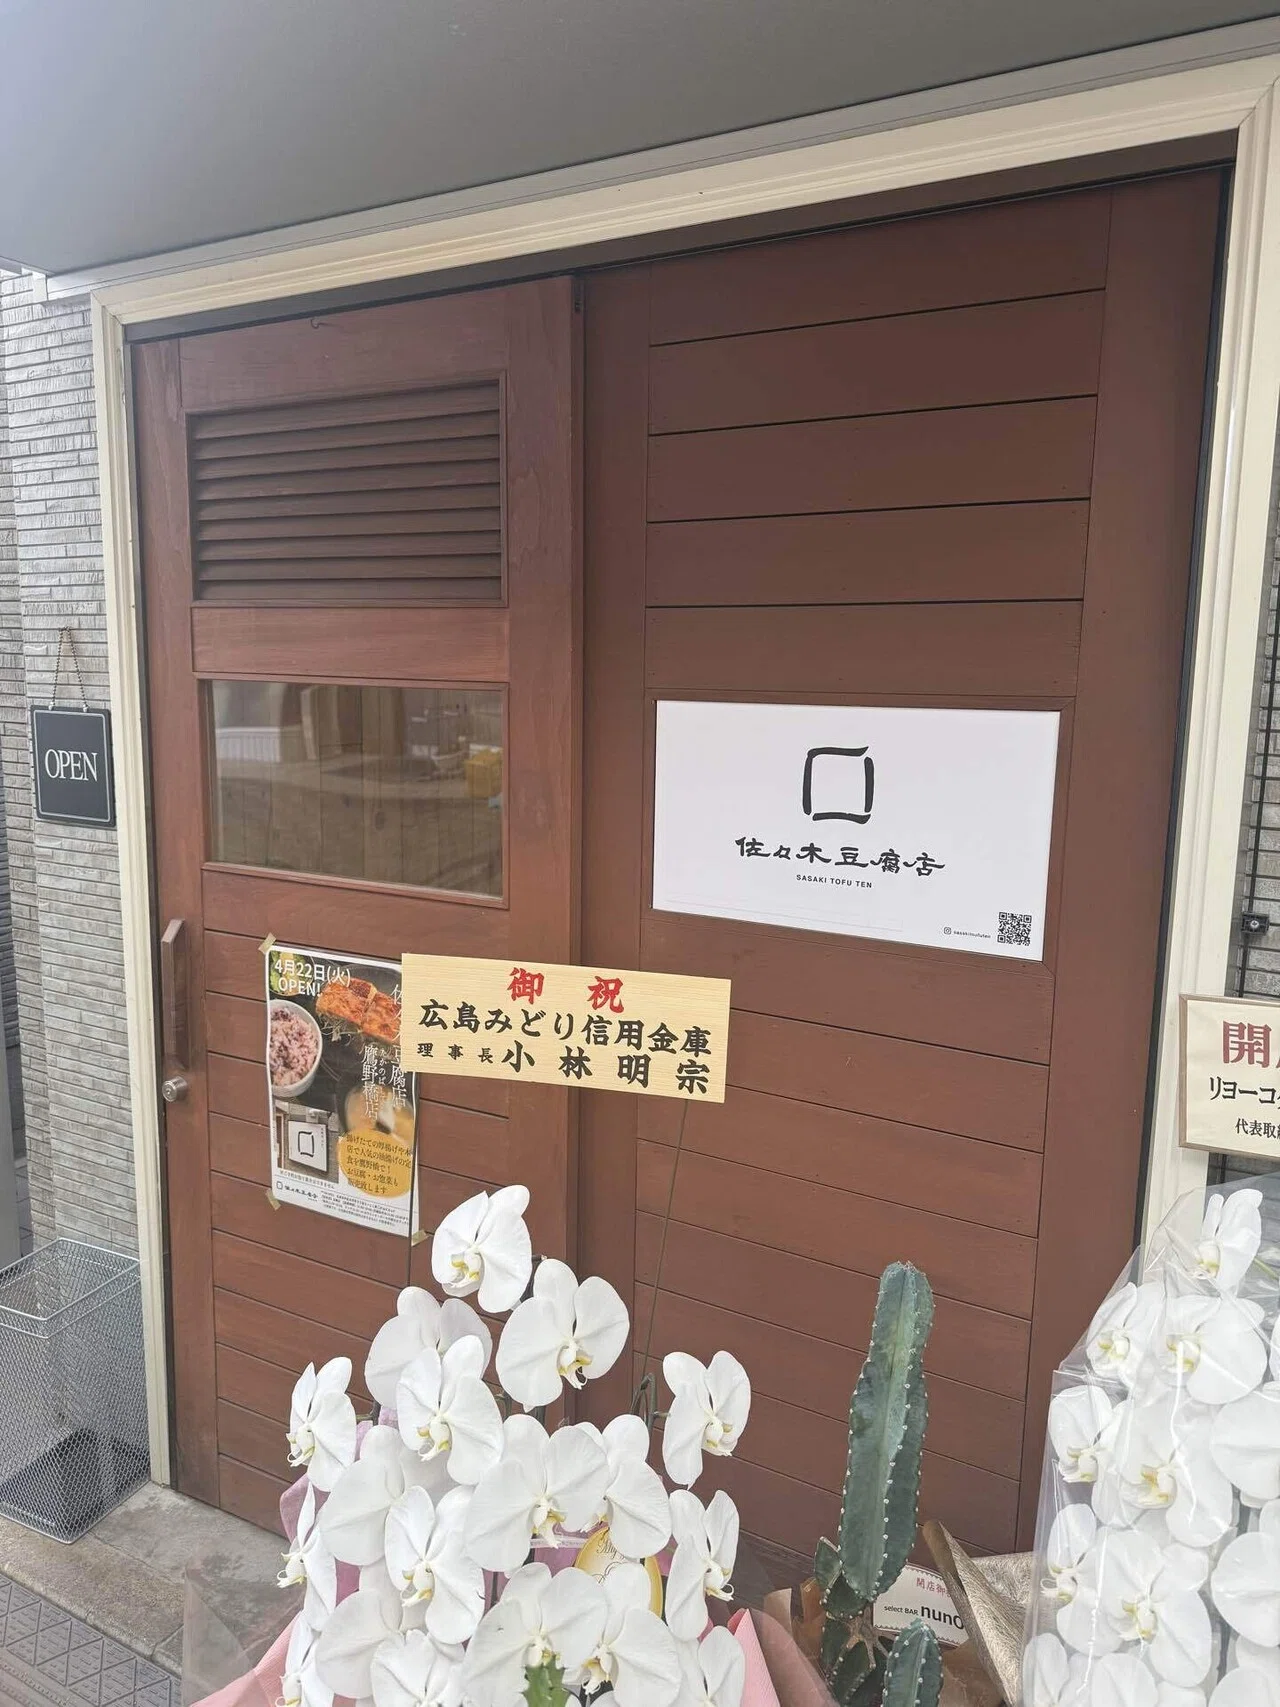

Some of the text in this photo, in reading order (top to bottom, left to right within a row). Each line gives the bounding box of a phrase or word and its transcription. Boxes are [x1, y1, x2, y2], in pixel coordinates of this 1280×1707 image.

[45, 749, 98, 781] OPEN
[735, 836, 945, 876] 佐々木豆腐店
[796, 874, 873, 888] SASAKI TOFU TEN
[275, 959, 351, 987] 4月22日(火)
[278, 977, 322, 997] OPEN!
[507, 966, 625, 1013] 御祝
[418, 999, 712, 1056] 広島みどり信用金庫
[1222, 1020, 1280, 1069] 開
[361, 1045, 379, 1120] 鷹野橋店
[417, 1039, 711, 1094] 理事長 小林明宗
[1235, 1118, 1280, 1139] 代表取
[916, 1578, 952, 1597] 開店御
[883, 1604, 904, 1614] select
[904, 1607, 919, 1616] BAR
